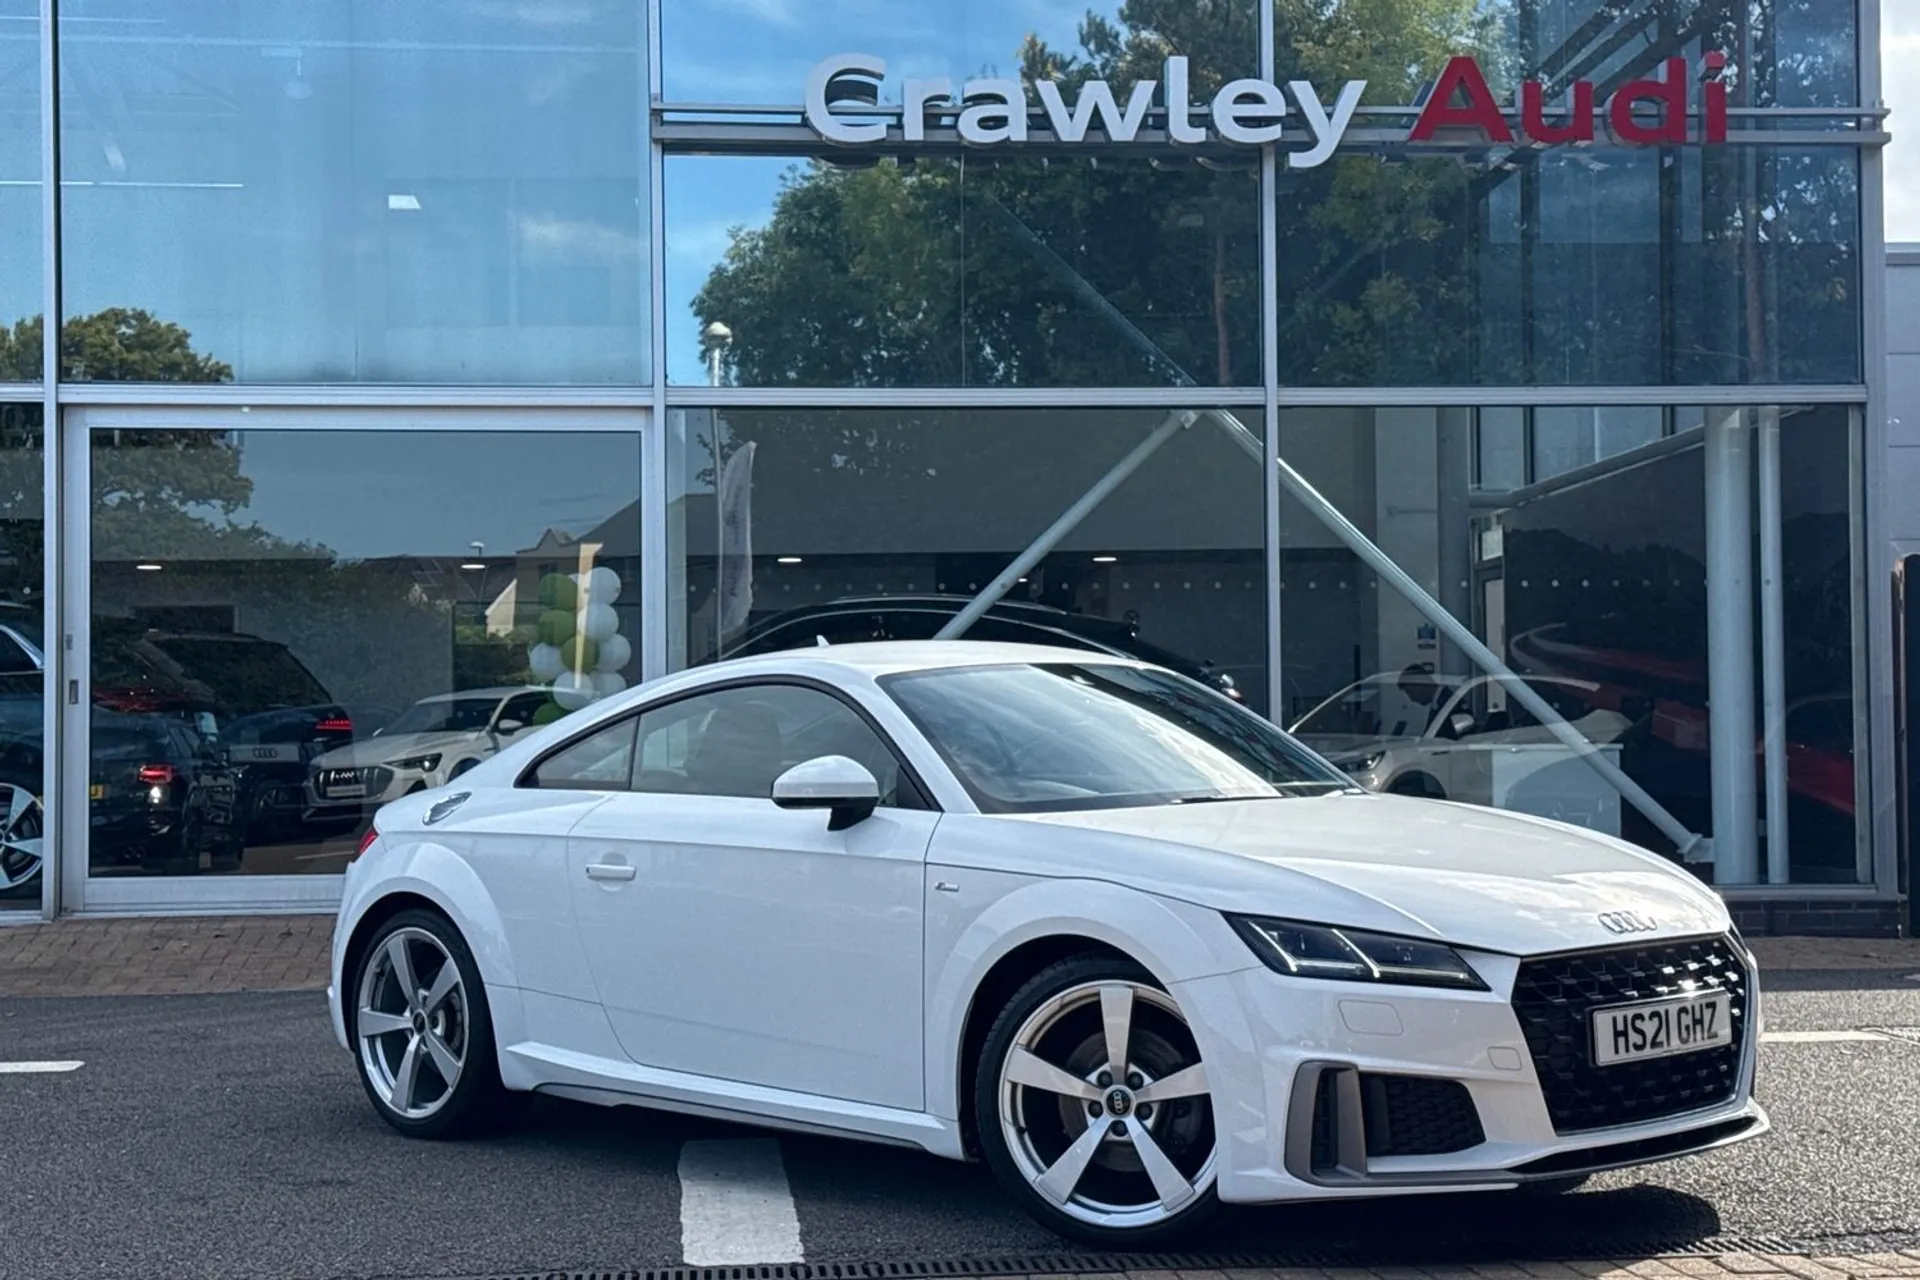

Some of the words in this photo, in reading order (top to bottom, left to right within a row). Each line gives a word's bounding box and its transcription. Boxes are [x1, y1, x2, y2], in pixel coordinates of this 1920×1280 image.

[805, 52, 1368, 168] Crawley
[1407, 50, 1727, 145] Audi
[1611, 1008, 1671, 1055] HS21
[1676, 1001, 1718, 1045] GHZ
